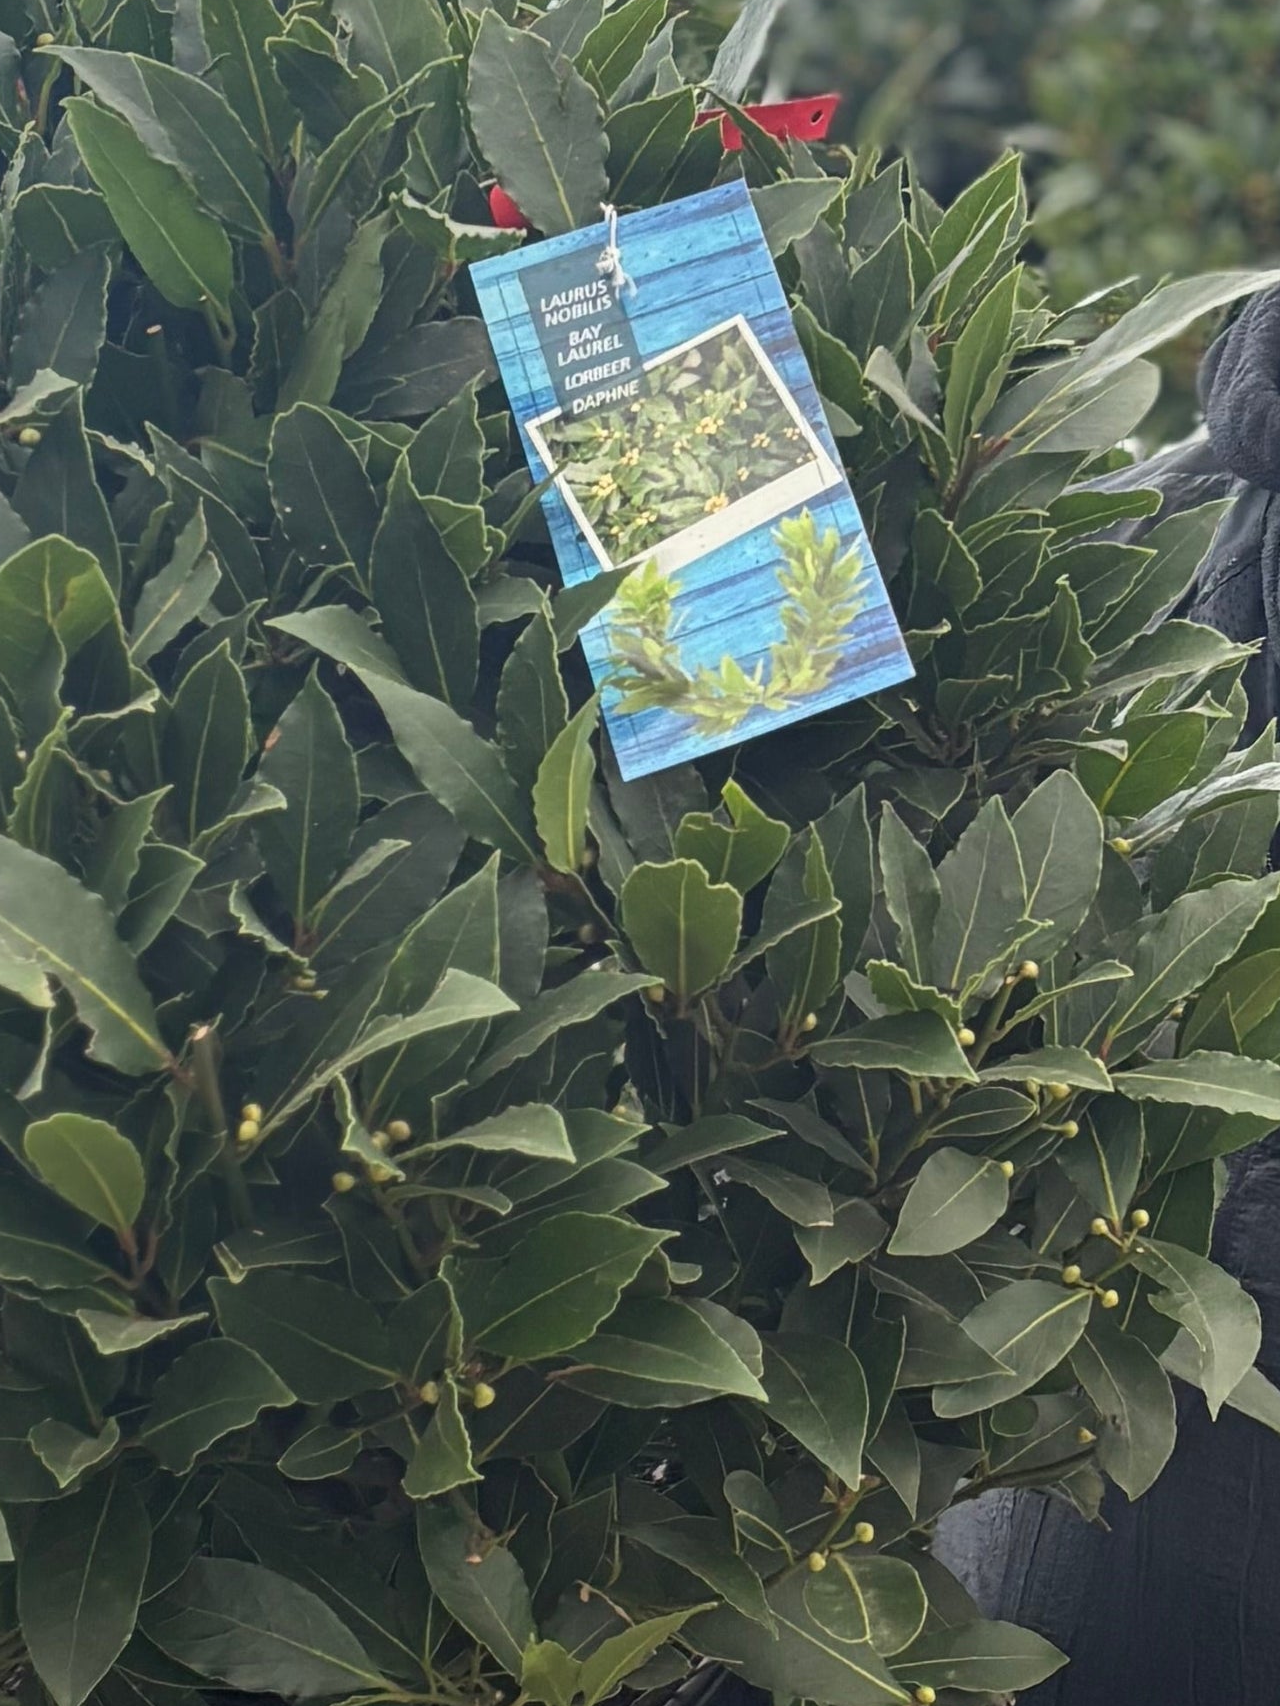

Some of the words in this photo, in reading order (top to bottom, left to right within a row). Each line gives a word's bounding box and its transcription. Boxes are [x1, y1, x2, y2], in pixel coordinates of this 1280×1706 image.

[540, 279, 608, 312] LAURUS
[545, 294, 613, 328] NOBILIS
[557, 334, 624, 367] LAUREL
[568, 323, 603, 347] BAY
[564, 356, 631, 391] LORBEER
[572, 379, 639, 415] DAPHNE
